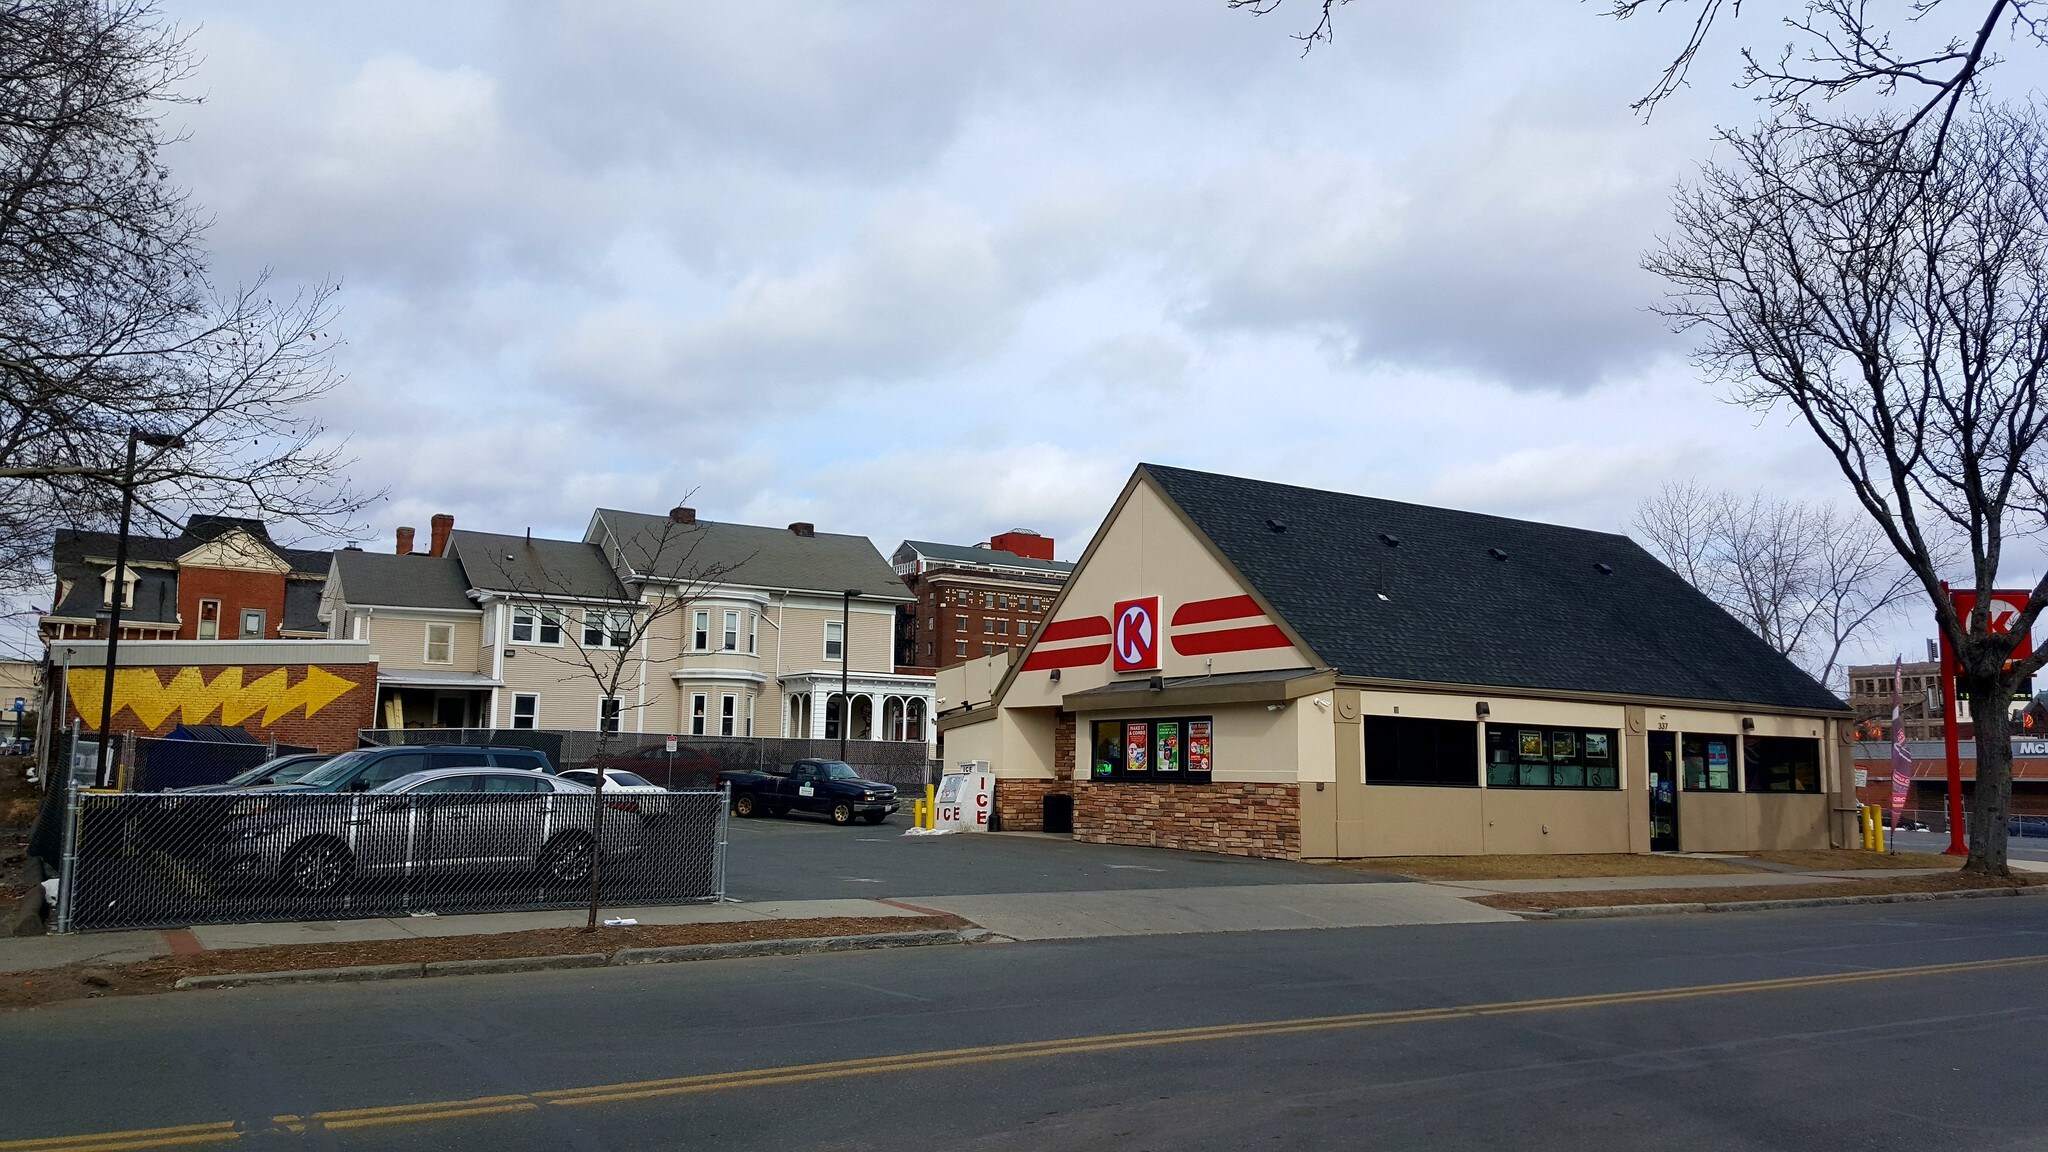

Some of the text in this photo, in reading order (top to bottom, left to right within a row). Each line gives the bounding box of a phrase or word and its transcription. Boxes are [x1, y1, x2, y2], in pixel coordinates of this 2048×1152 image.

[1658, 722, 1669, 730] 337
[2019, 742, 2048, 754] Mc
[976, 776, 988, 825] ICE
[936, 806, 960, 821] ICE
